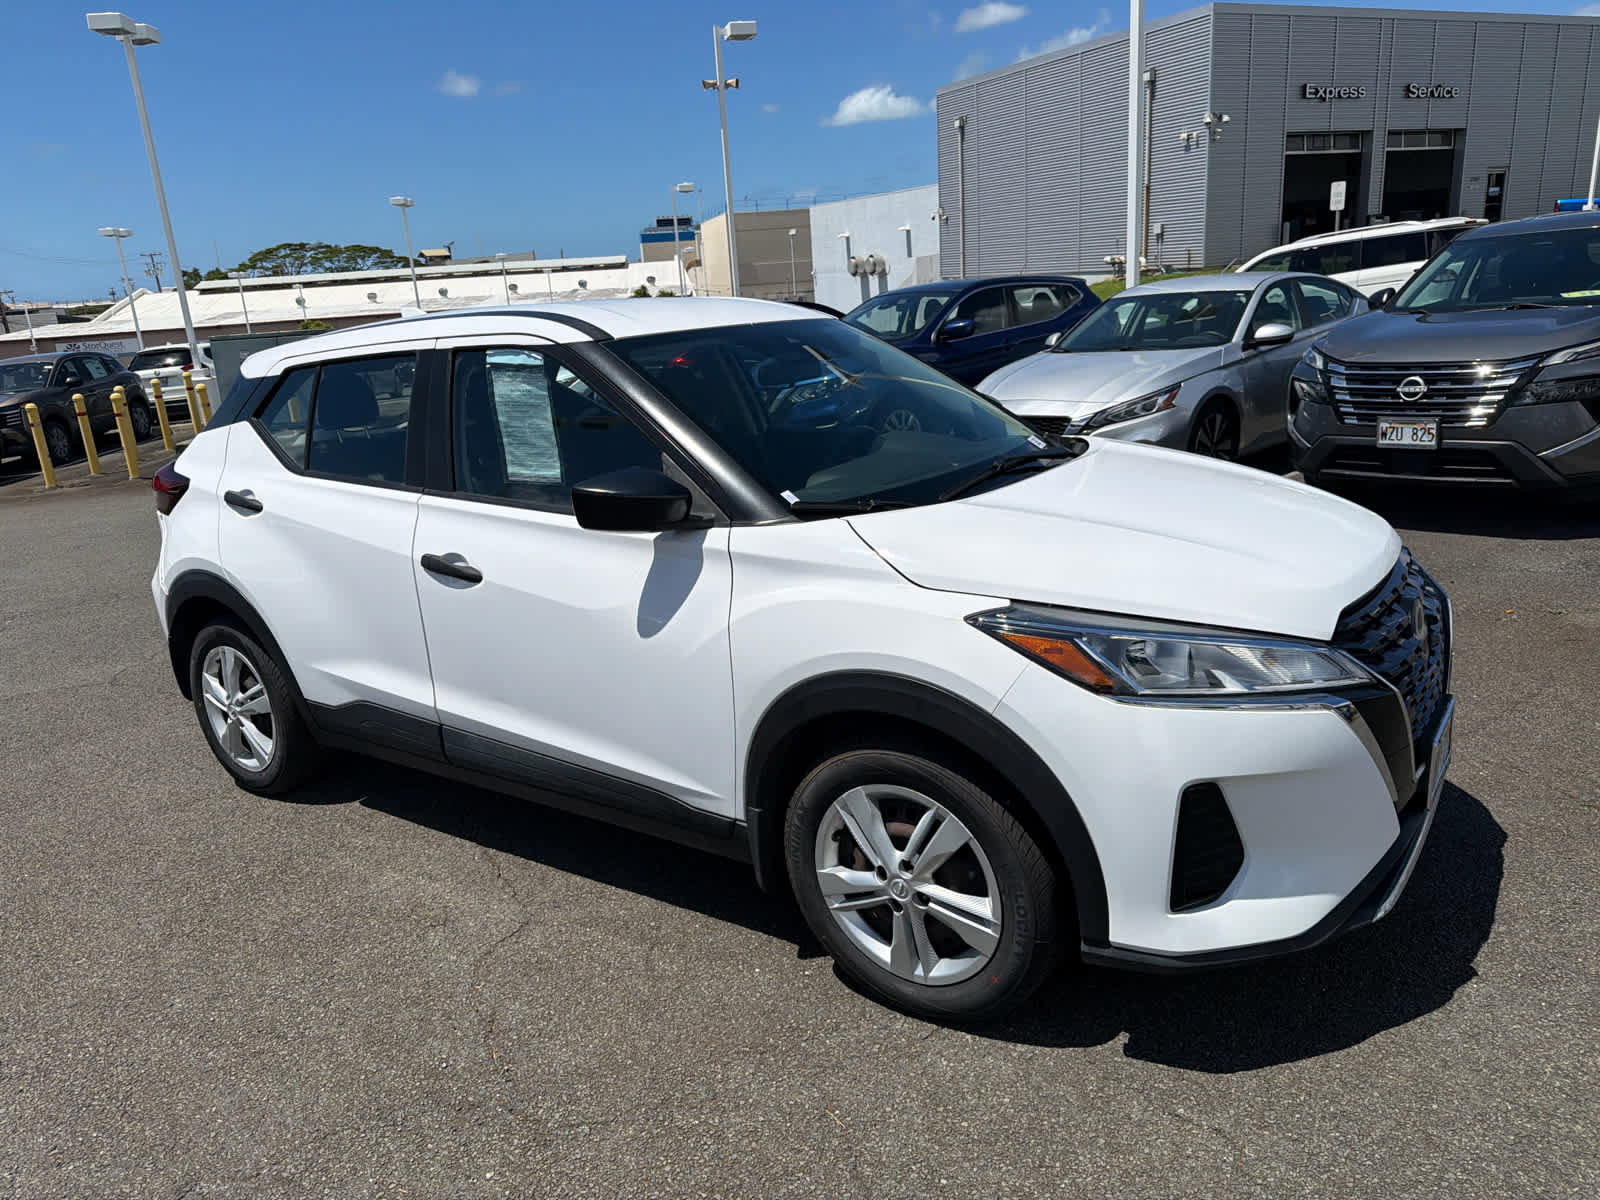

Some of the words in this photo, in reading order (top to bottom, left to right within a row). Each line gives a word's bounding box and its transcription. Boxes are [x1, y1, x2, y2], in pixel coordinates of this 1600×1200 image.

[1304, 83, 1367, 101] Express
[1407, 83, 1460, 99] Service
[1380, 426, 1404, 441] WZU
[1411, 427, 1435, 442] 825
